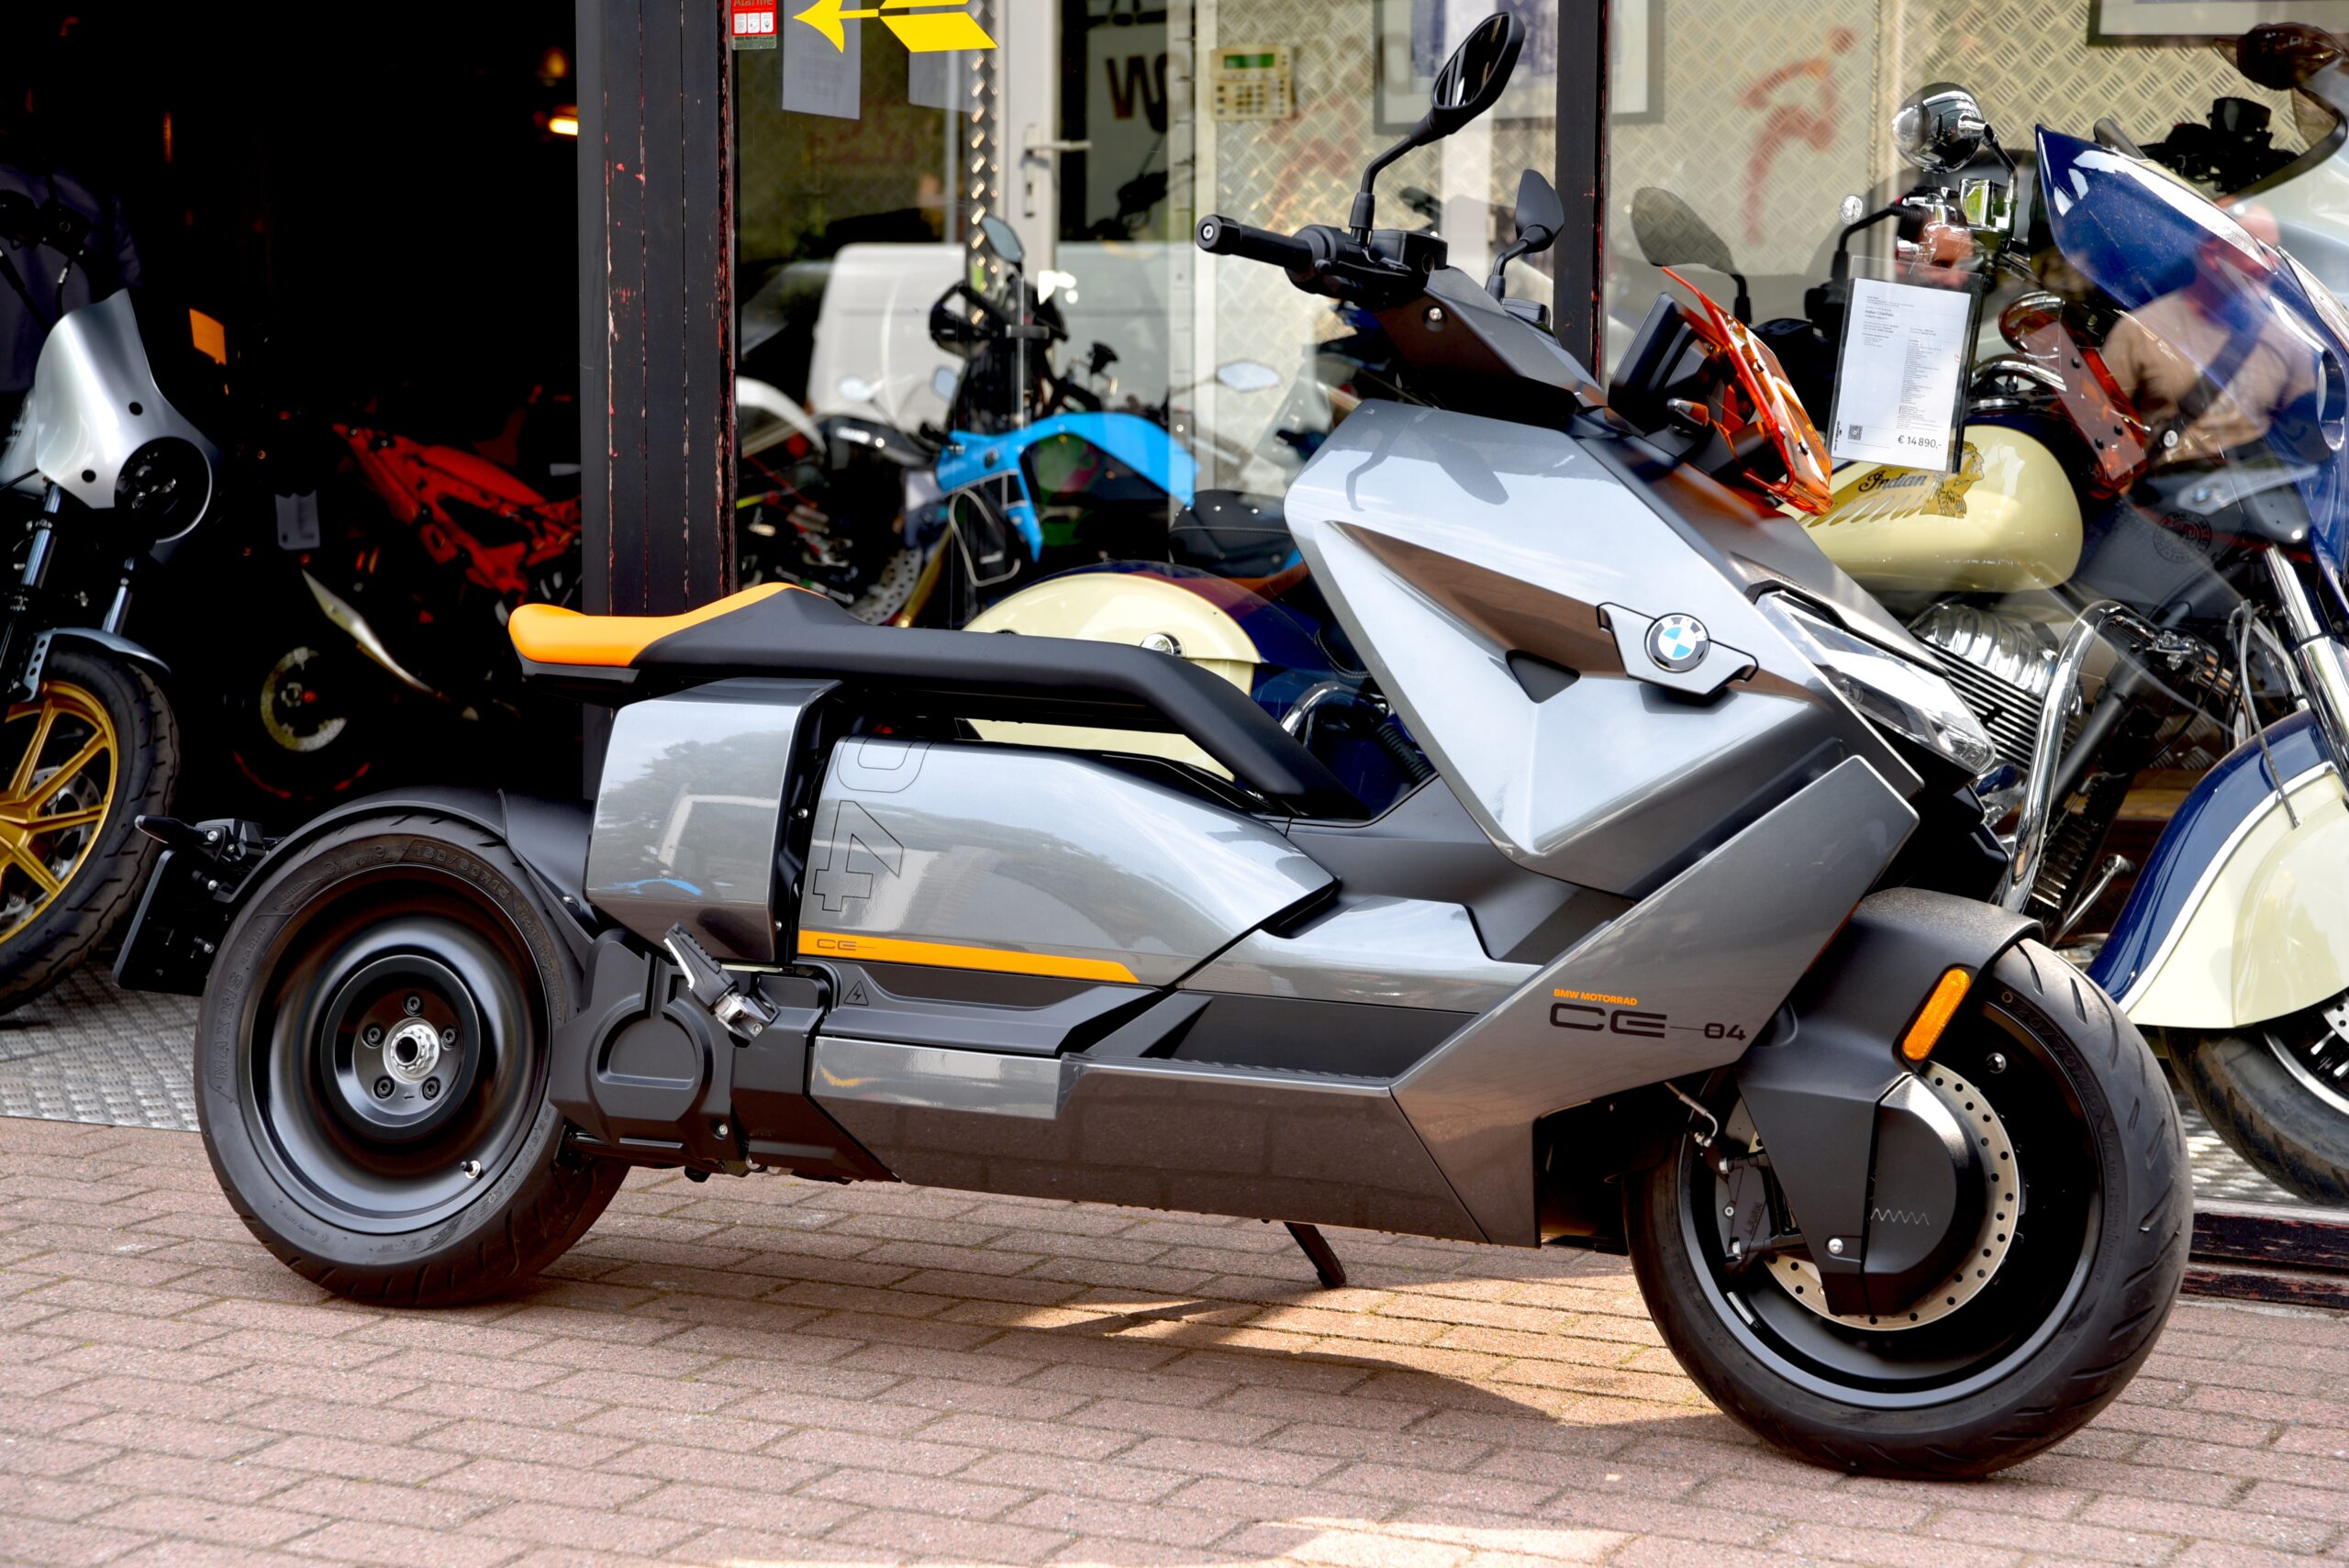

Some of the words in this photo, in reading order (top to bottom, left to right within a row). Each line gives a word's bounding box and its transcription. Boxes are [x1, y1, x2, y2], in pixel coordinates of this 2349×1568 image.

[1858, 470, 1928, 493] Indian
[816, 938, 857, 951] CE
[1553, 988, 1580, 999] BMW
[1580, 992, 1638, 1006] MOTORRAD
[1549, 1002, 1668, 1040] CE
